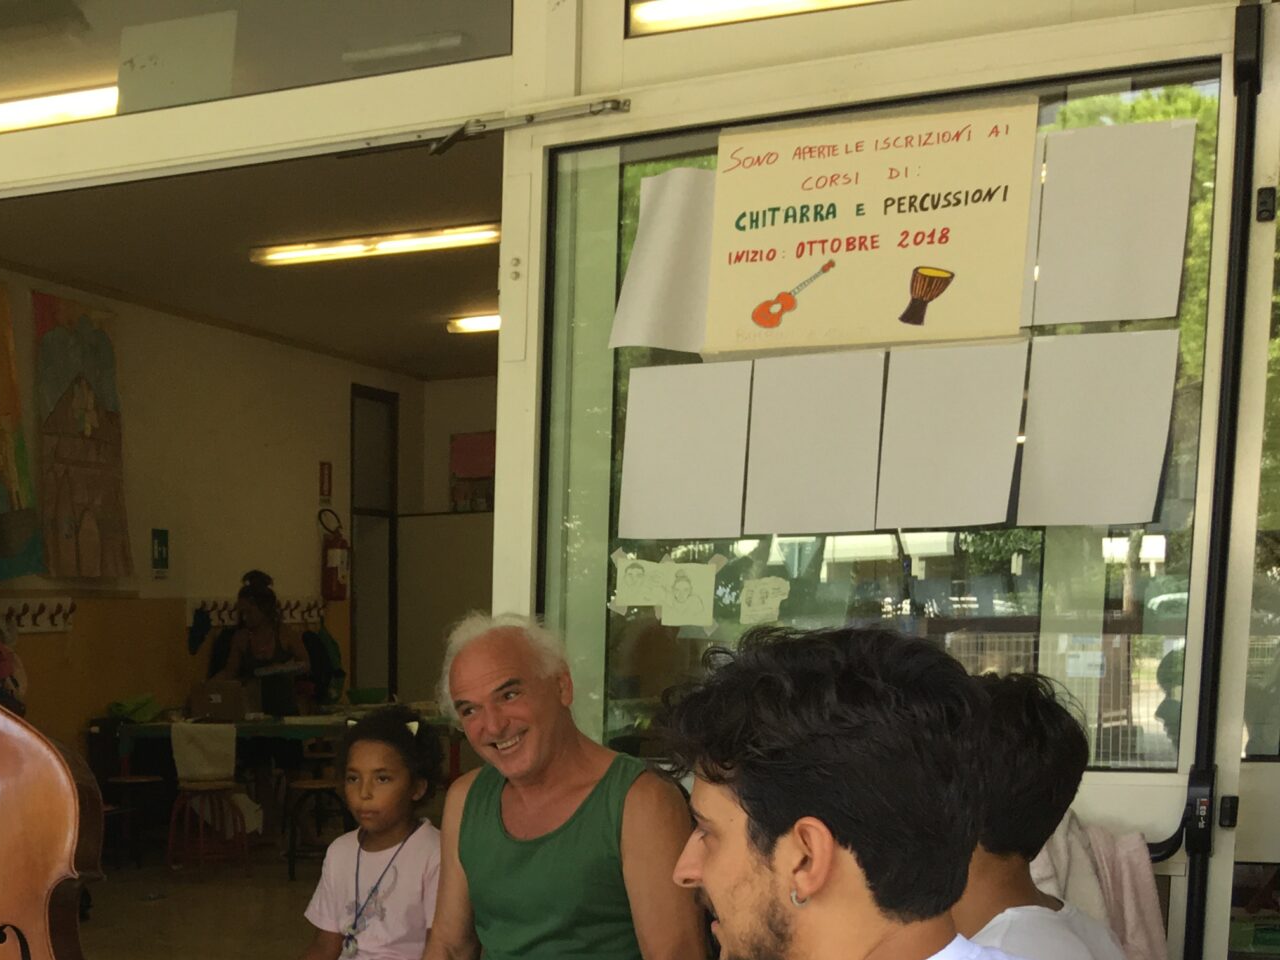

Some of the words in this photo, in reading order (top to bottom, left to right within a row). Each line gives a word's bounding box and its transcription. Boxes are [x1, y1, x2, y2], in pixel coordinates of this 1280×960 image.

[792, 144, 839, 160] APERTE
[845, 140, 865, 154] LE
[875, 124, 971, 151] ISCRIZIONI
[988, 124, 1009, 138] AI
[801, 172, 859, 191] CORSI
[734, 202, 837, 232] CHITARRA
[855, 203, 866, 217] E
[883, 184, 1009, 215] PERCUSSIONI
[795, 234, 880, 259] OTTOBRE
[897, 227, 950, 248] 2018
